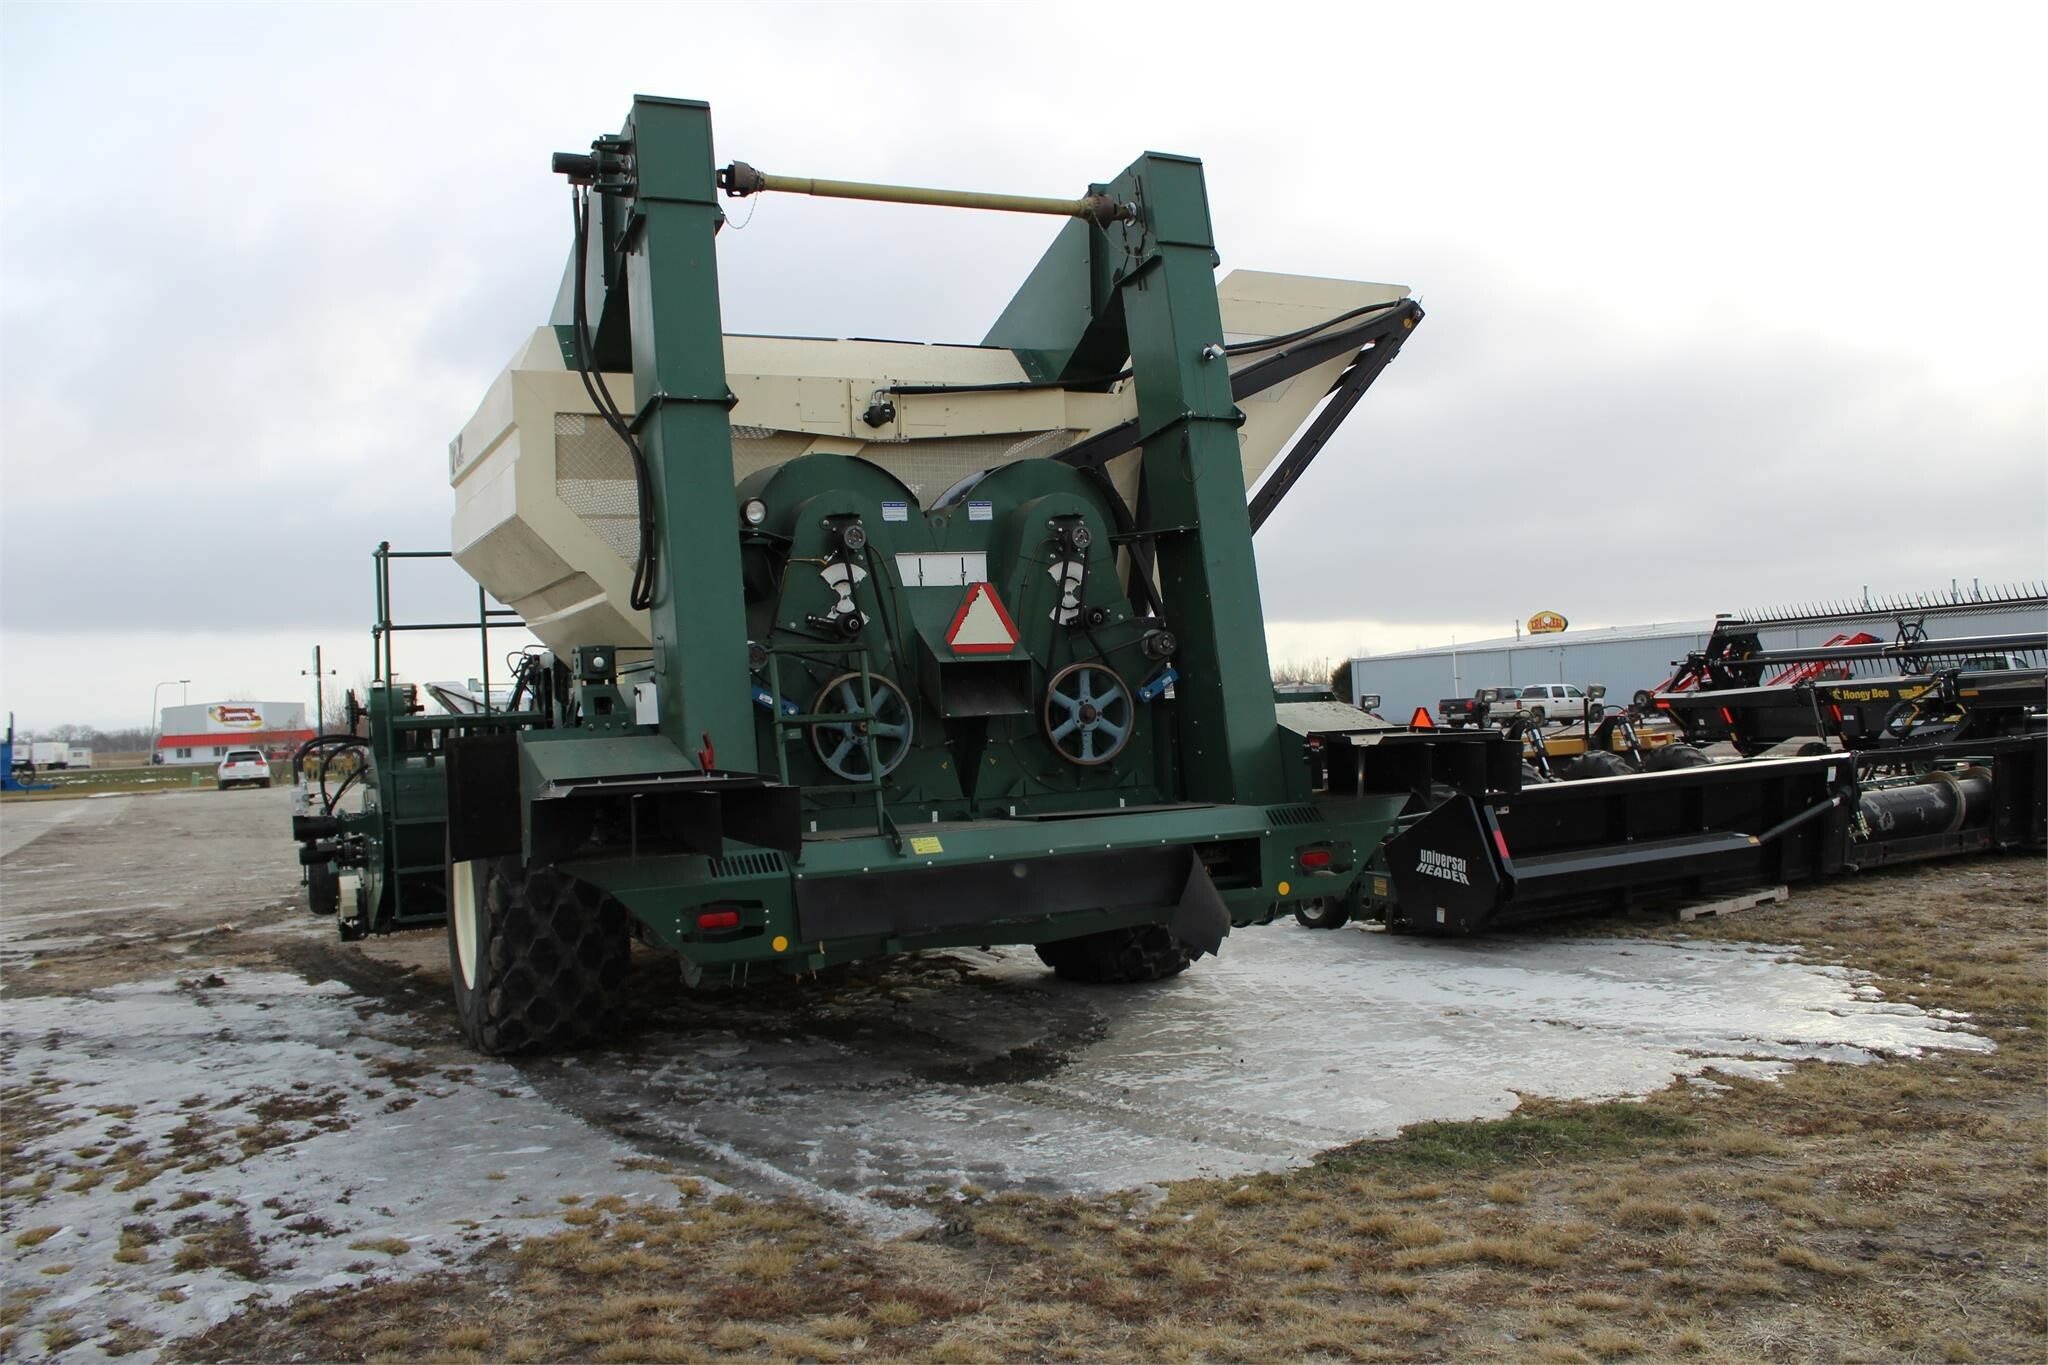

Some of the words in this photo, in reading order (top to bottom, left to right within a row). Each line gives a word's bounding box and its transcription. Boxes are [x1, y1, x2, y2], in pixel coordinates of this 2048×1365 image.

[1843, 689, 1871, 701] Honey
[1872, 688, 1890, 698] Bee
[1416, 862, 1470, 886] HEADER
